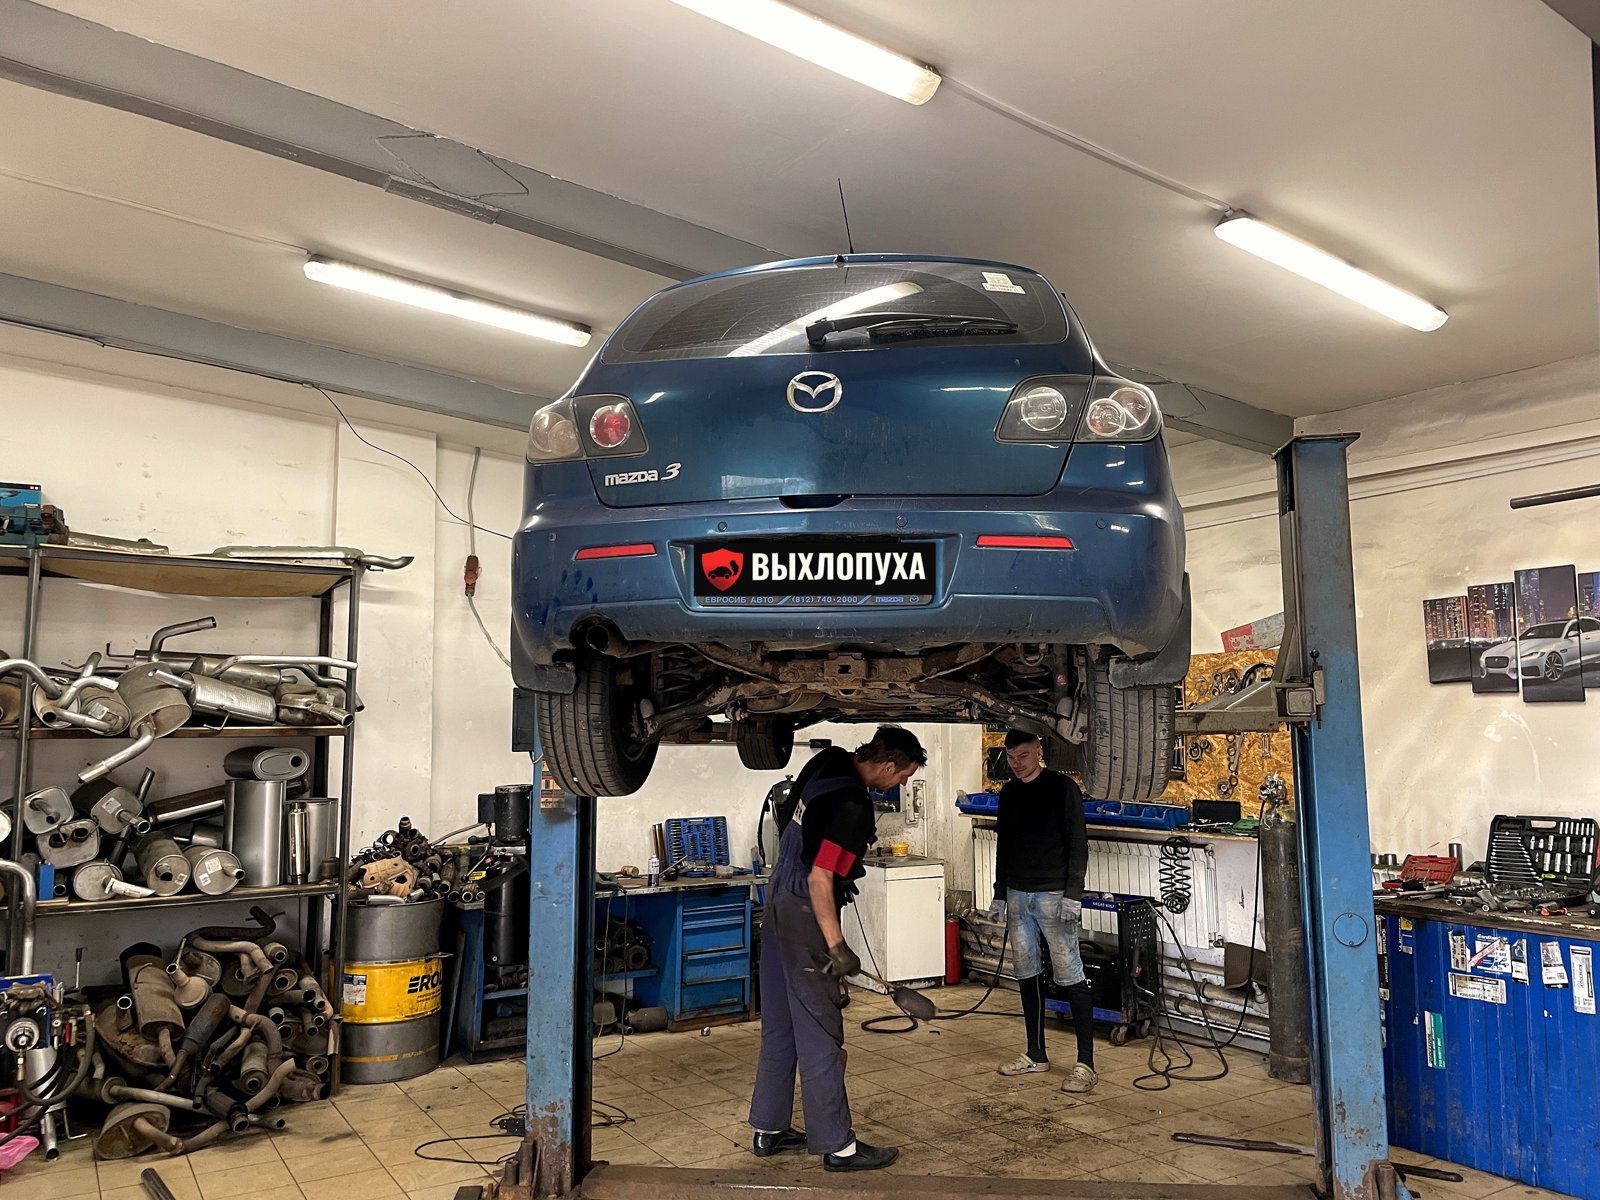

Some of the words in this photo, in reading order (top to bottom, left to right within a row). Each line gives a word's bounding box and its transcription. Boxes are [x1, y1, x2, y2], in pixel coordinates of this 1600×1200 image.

[604, 469, 659, 487] mazda
[660, 462, 682, 481] 3
[705, 595, 747, 604] ЕВРОСИБ
[750, 595, 774, 604] АВТО
